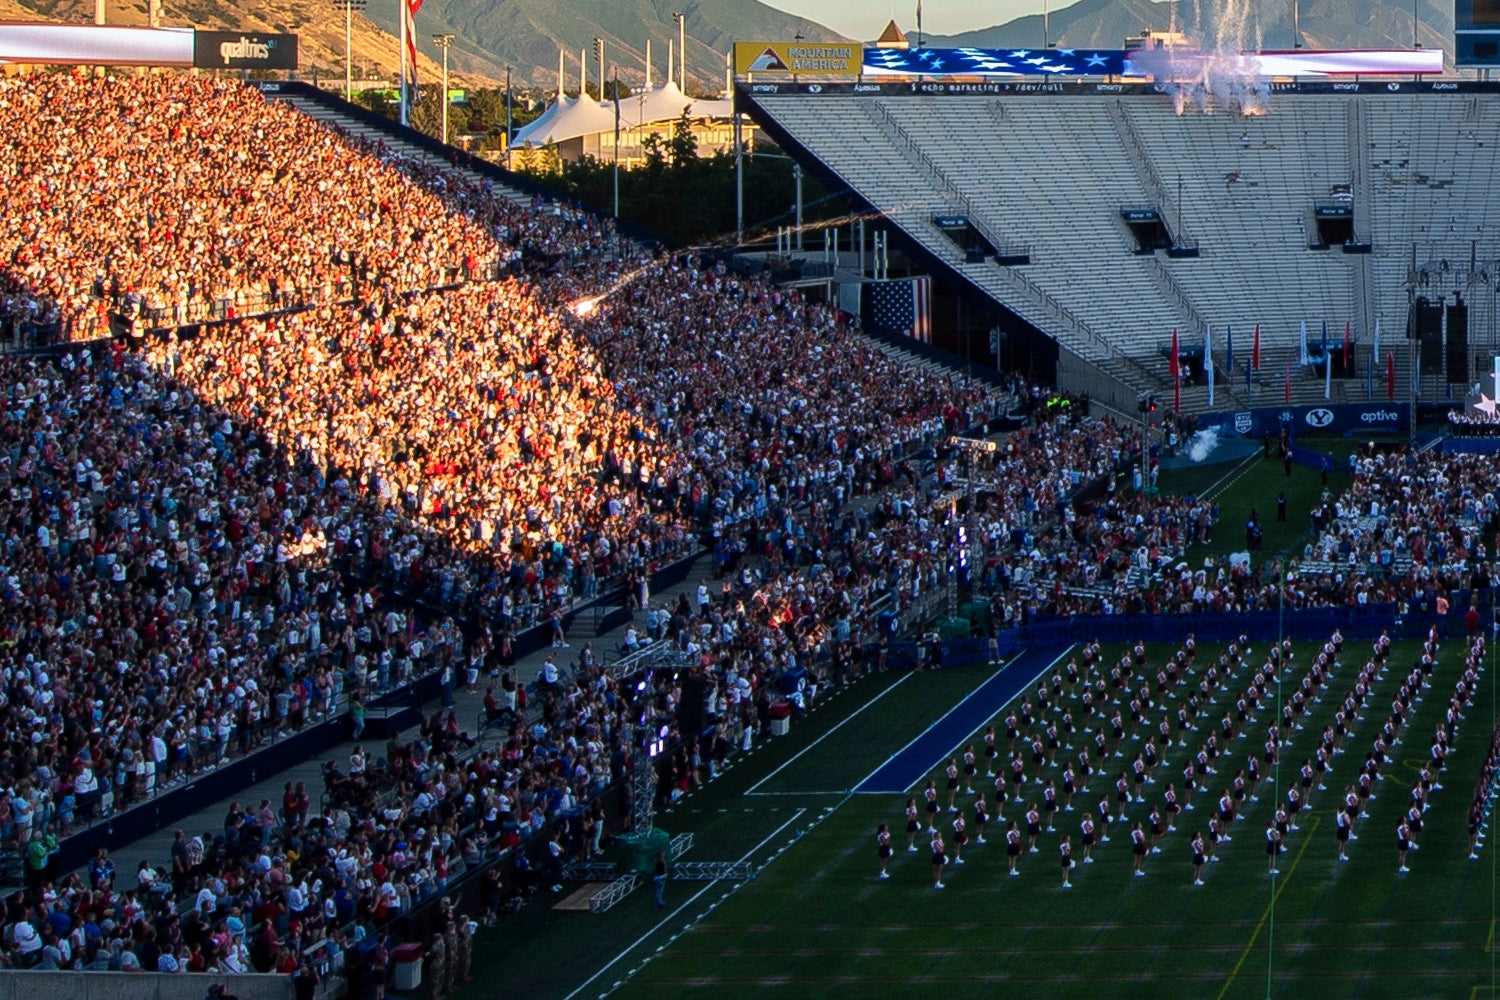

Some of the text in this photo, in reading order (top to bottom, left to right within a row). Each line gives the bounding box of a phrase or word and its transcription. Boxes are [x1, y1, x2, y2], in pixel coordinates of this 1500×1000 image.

[220, 36, 269, 64] qualtrics
[787, 47, 852, 58] MOUNTAIN
[792, 59, 849, 70] AMERICA
[949, 84, 999, 93] marketing
[1360, 410, 1398, 423] aptive
